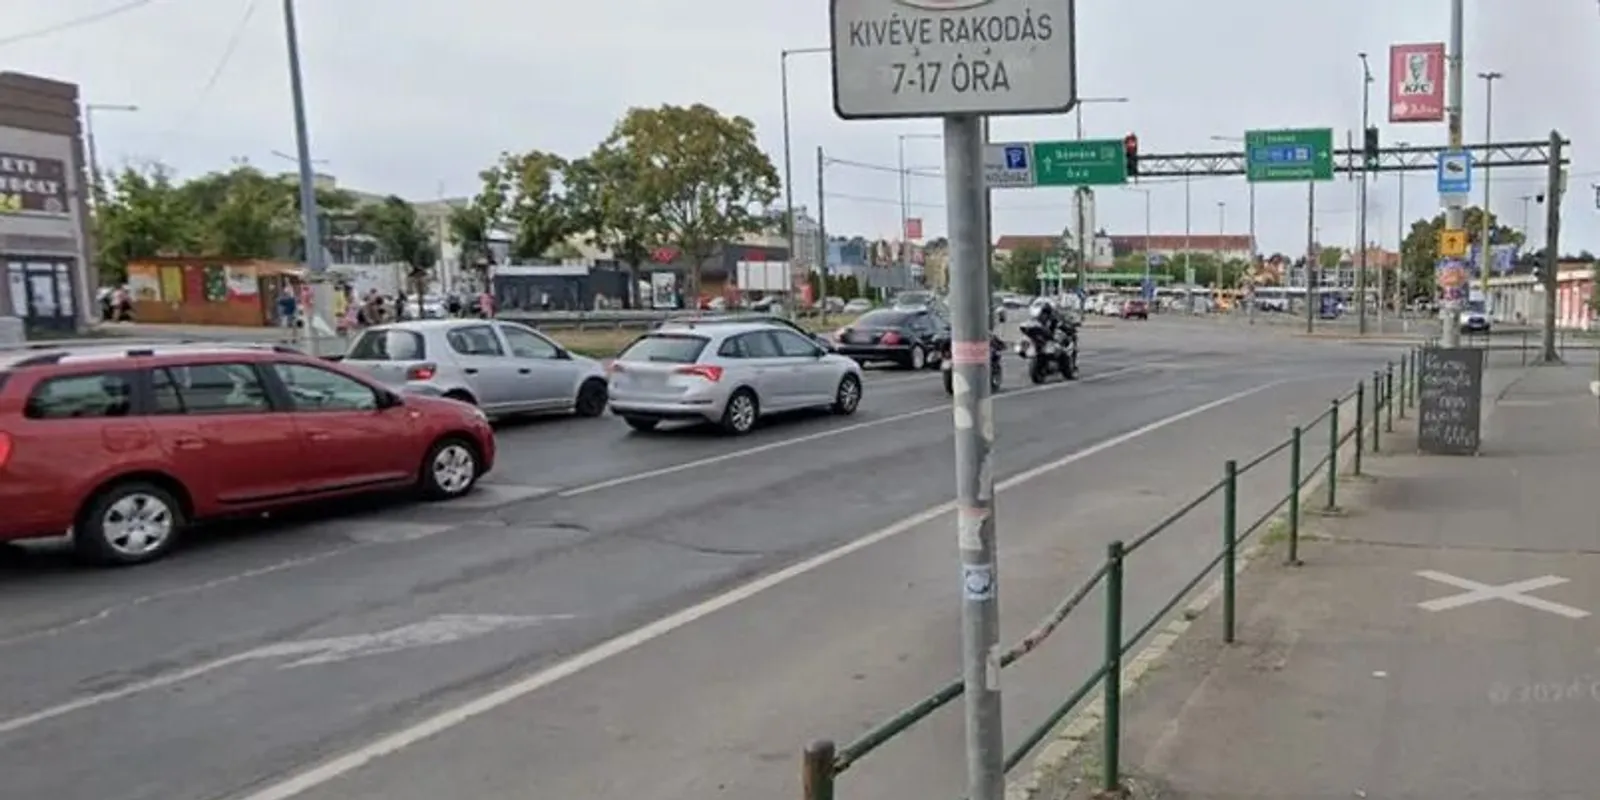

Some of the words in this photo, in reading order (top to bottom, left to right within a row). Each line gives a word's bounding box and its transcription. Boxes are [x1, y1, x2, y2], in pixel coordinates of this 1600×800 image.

[850, 12, 933, 47] KIVÉVE
[940, 8, 1053, 44] RAKODÁS
[891, 61, 943, 94] 7-17
[951, 53, 1011, 92] ÓRA
